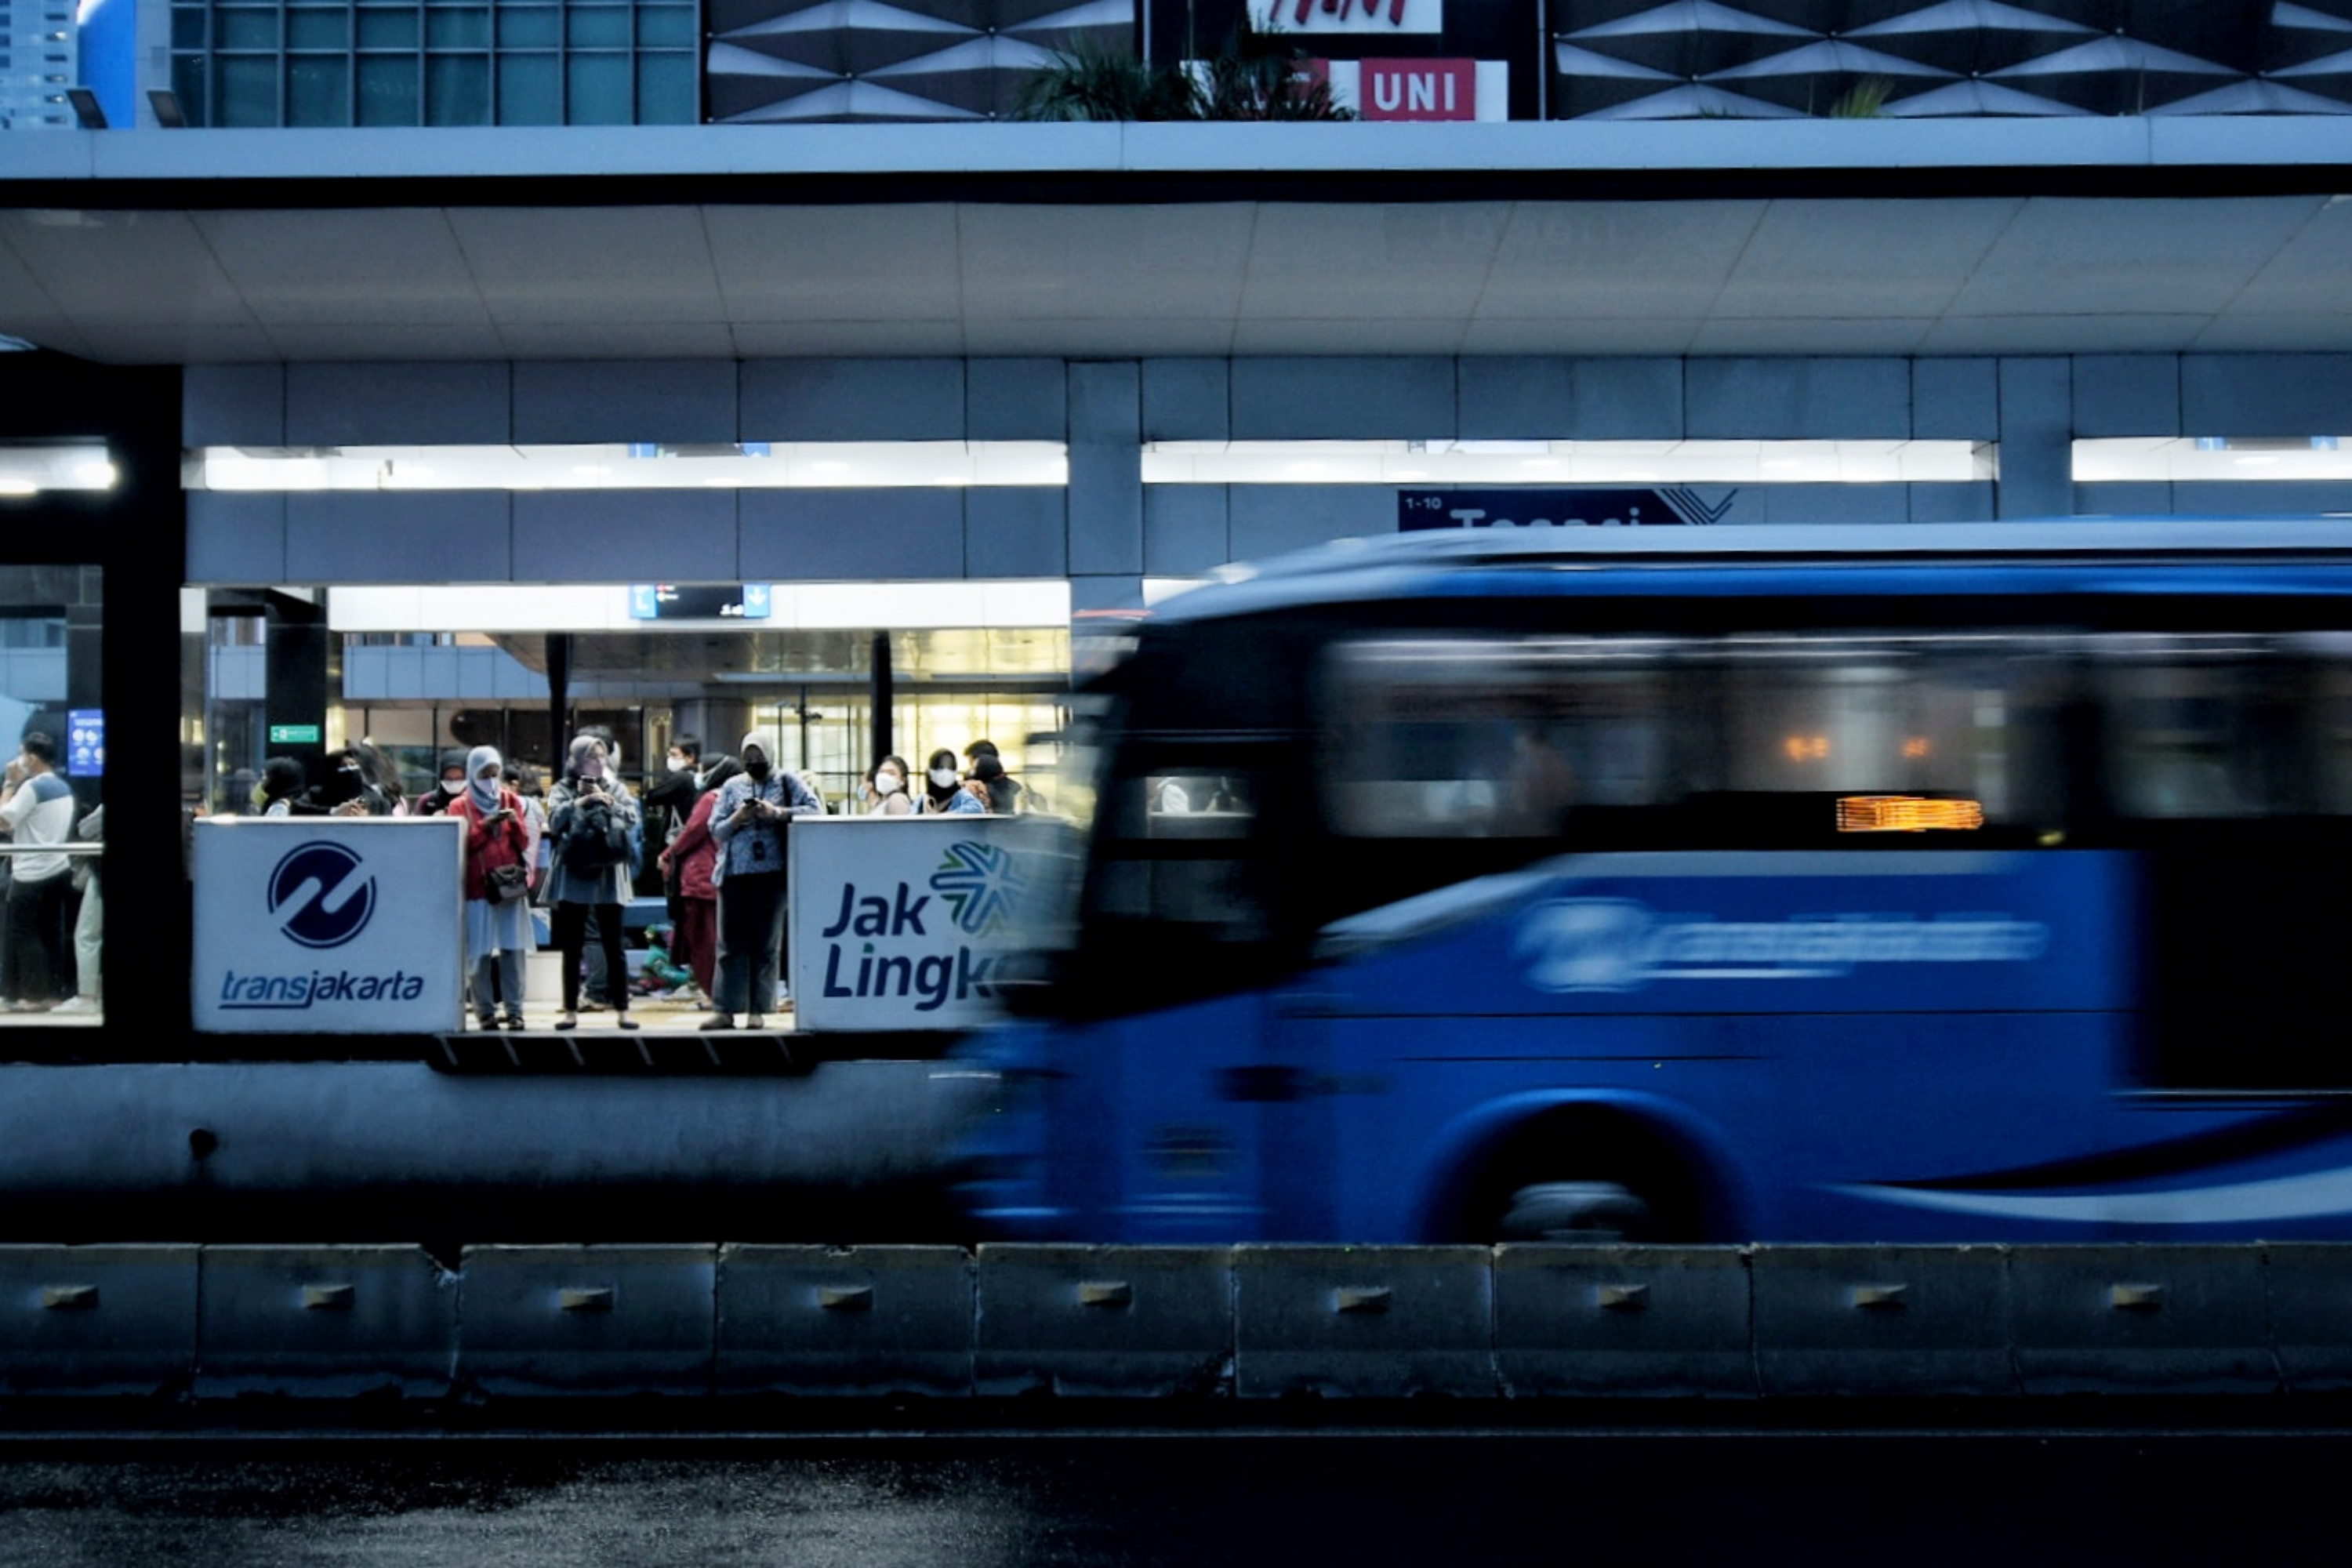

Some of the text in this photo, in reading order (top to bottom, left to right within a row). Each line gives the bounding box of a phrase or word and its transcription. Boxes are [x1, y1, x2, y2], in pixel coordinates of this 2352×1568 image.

[1374, 72, 1455, 111] UNI
[1405, 497, 1443, 510] 1-10
[822, 881, 931, 938] Jak
[218, 970, 424, 1010] transjakarta
